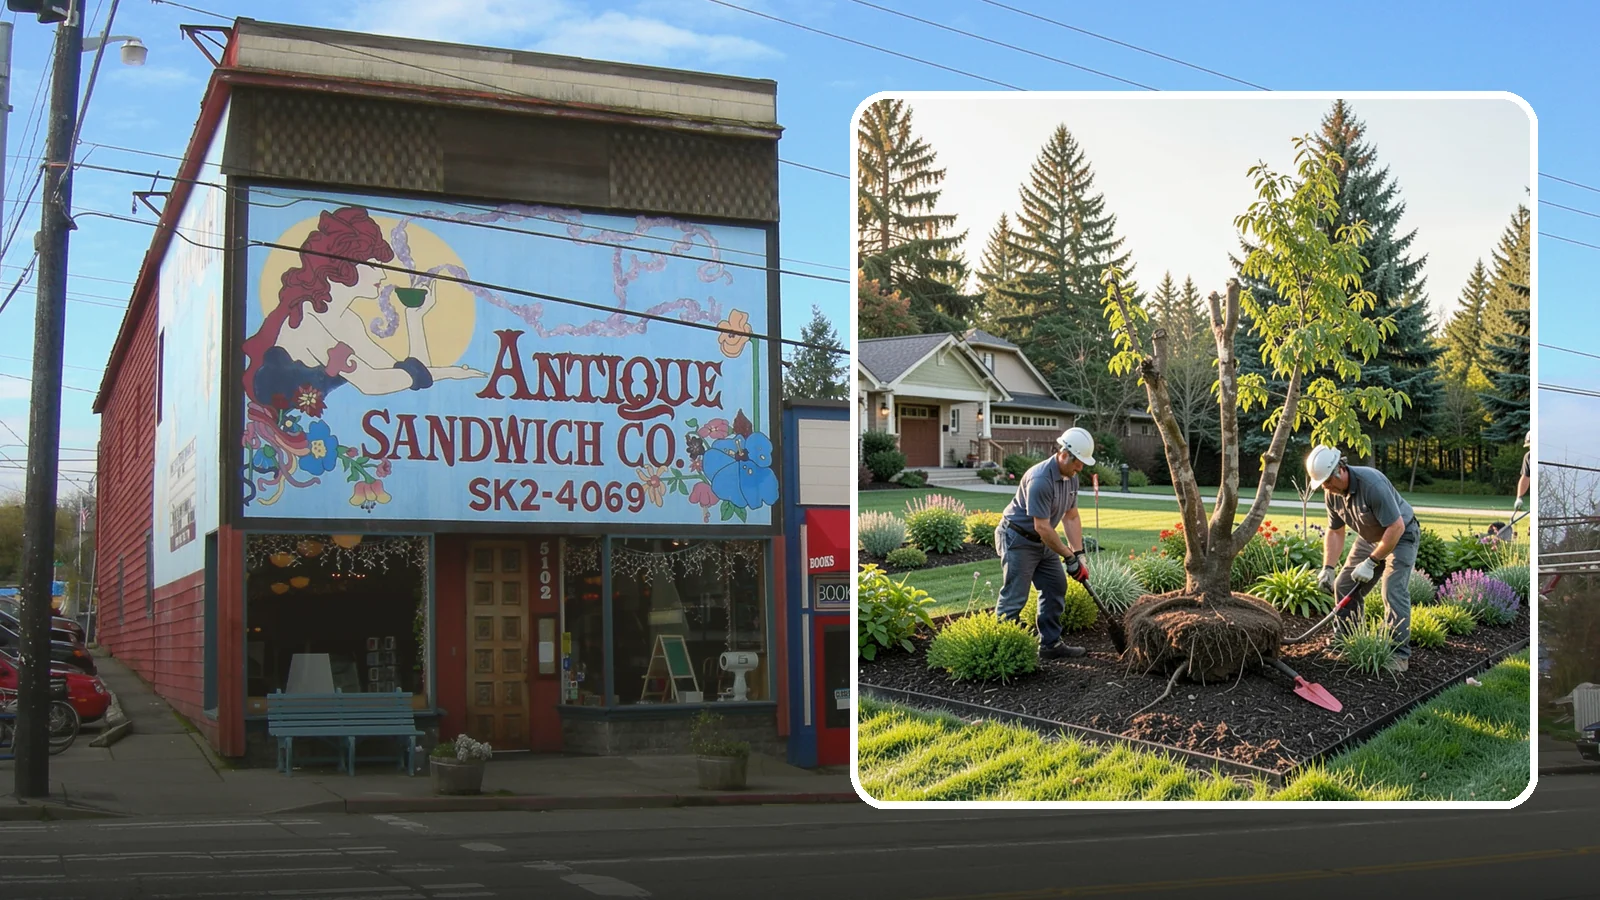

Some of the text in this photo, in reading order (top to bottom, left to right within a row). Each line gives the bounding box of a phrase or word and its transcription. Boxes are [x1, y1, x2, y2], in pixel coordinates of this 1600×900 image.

[476, 329, 723, 421] ANTIQUE
[361, 409, 684, 469] SANDWICH CO.
[469, 478, 645, 513] SK2-4069
[540, 541, 552, 599] 5102
[809, 554, 835, 569] BOOKS
